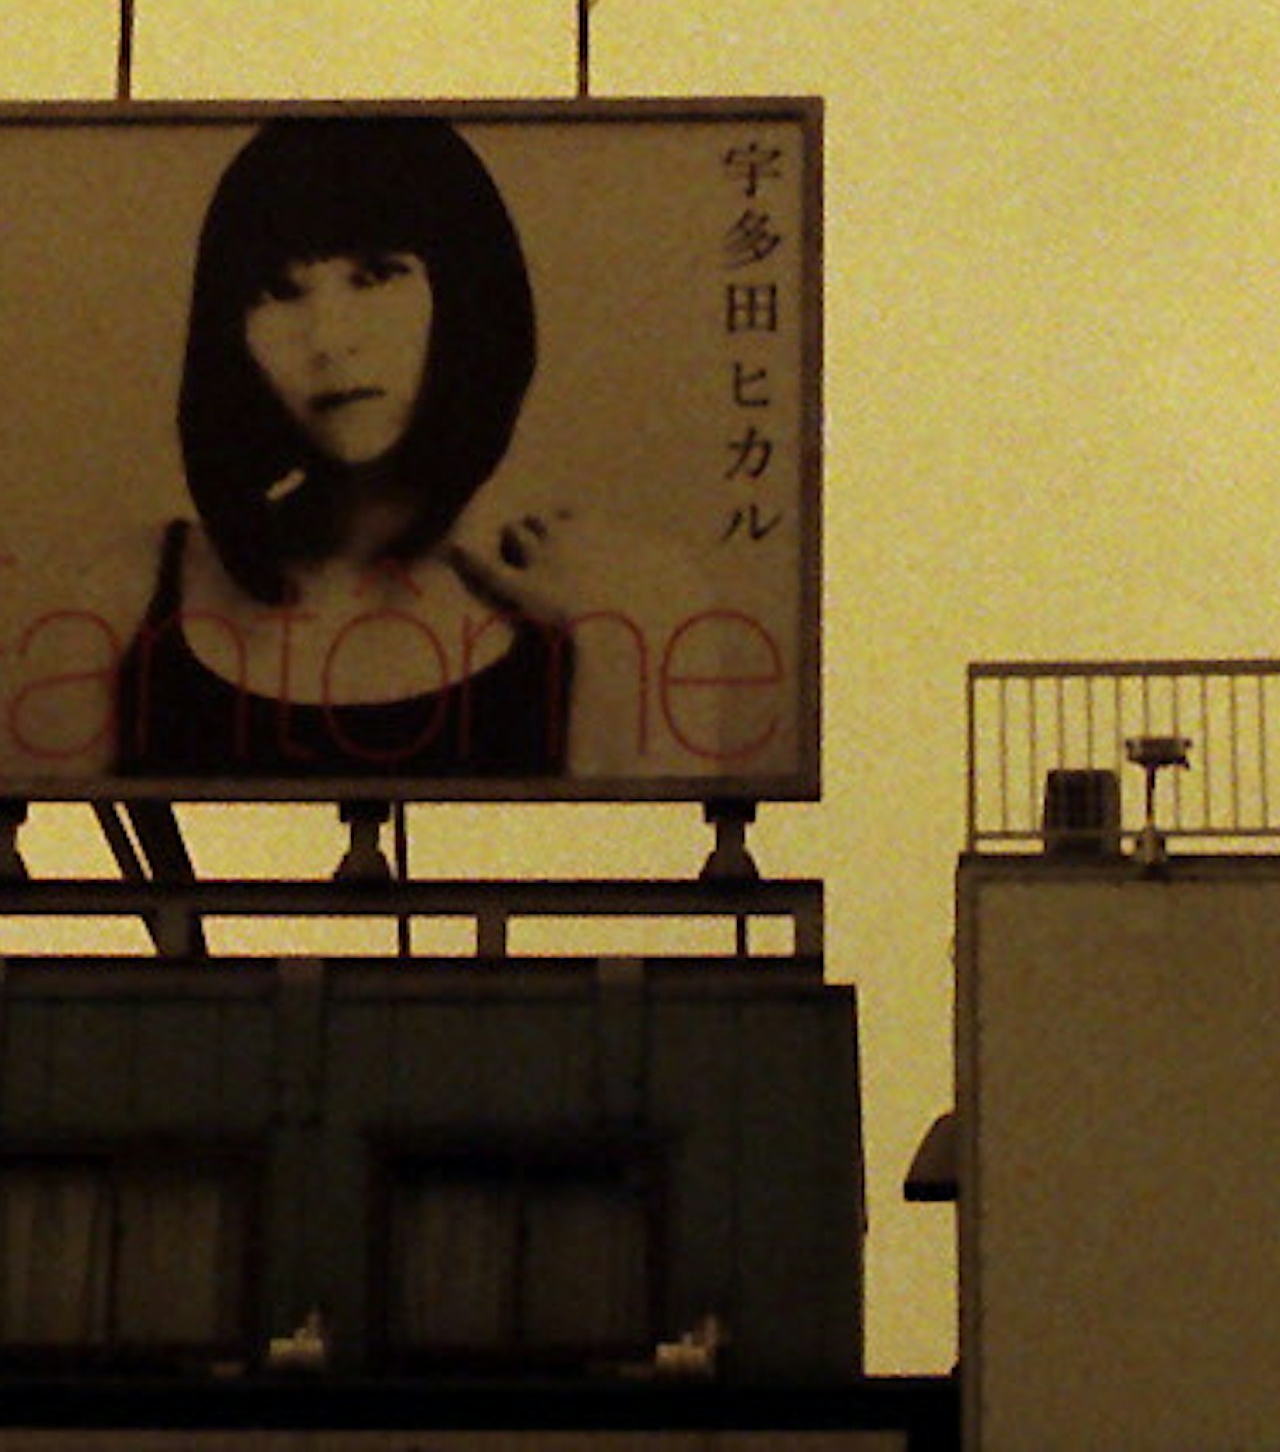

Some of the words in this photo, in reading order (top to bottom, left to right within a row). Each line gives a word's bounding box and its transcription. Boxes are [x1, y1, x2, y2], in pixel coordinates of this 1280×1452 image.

[722, 142, 782, 544] 宇多田ヒカル
